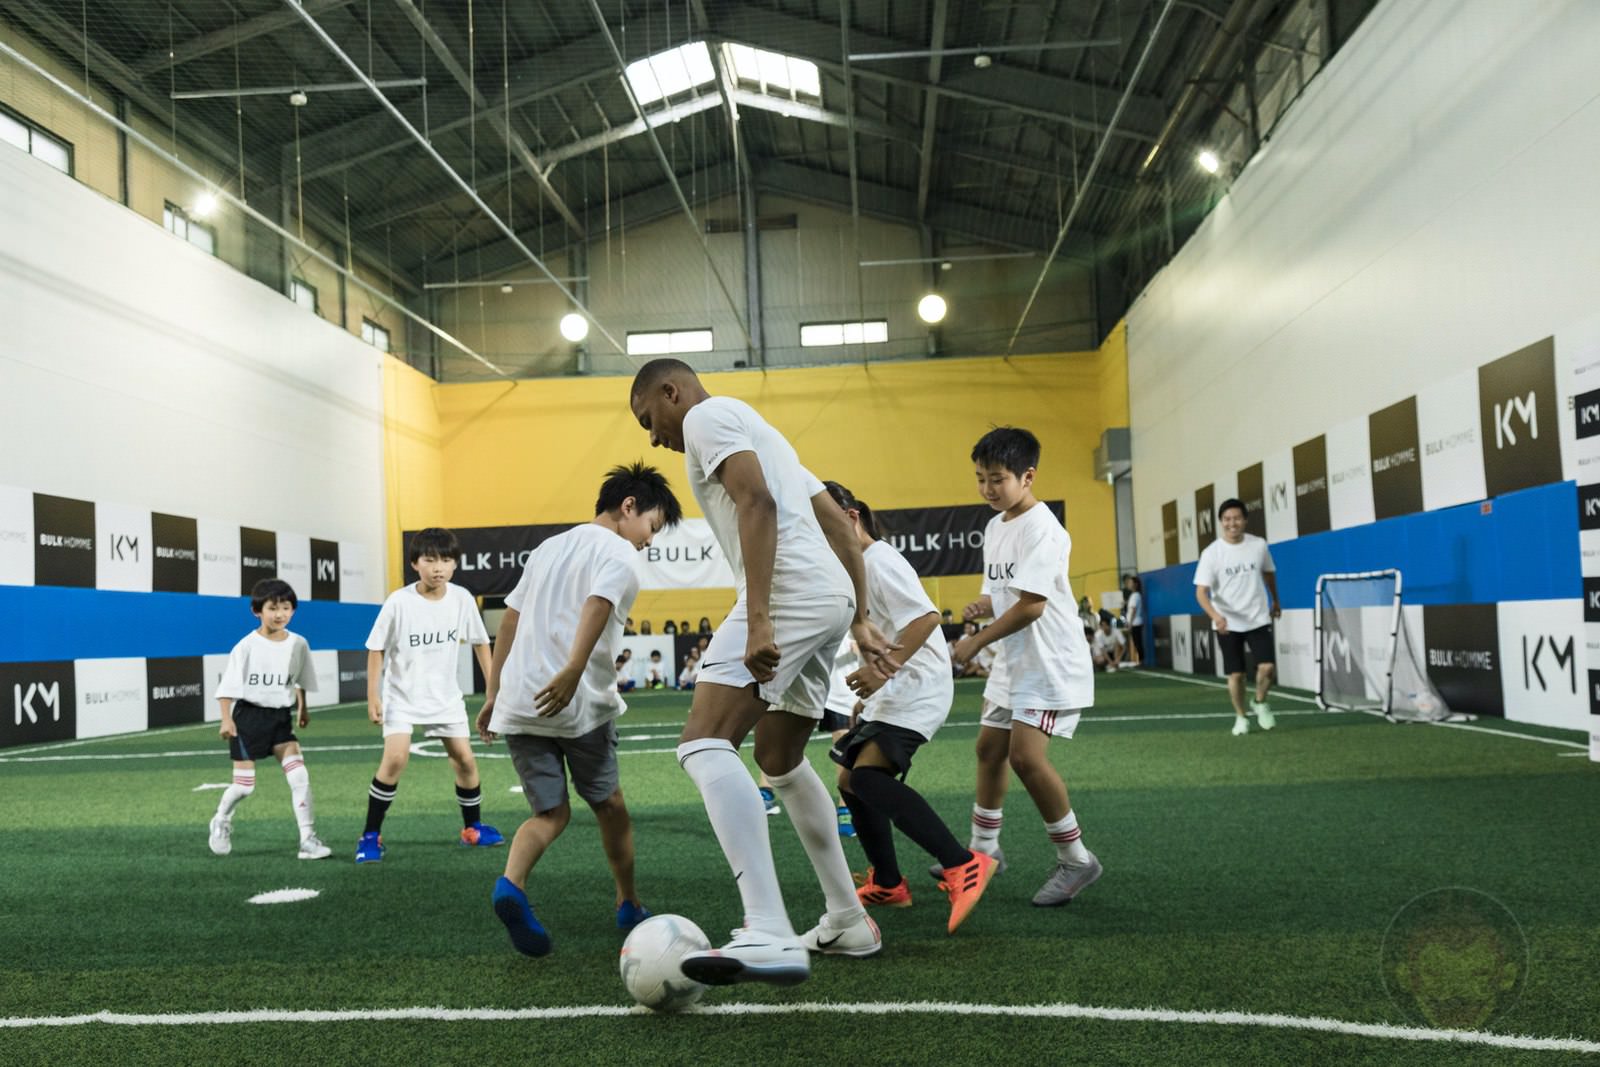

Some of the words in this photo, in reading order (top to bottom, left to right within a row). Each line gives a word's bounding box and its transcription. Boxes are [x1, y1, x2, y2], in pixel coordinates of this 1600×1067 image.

[1494, 390, 1538, 449] KM
[1373, 455, 1390, 473] BULK
[40, 533, 63, 547] BULK
[110, 533, 139, 562] KM
[891, 532, 941, 551] ULK
[155, 546, 174, 558] BULK
[648, 545, 713, 562] BULK
[317, 558, 336, 583] KM
[461, 552, 492, 571] LK
[988, 563, 1014, 581] ULK
[409, 630, 457, 647] BULK
[1429, 649, 1453, 667] BULK
[1523, 634, 1577, 695] KM
[248, 673, 295, 687] BULK
[86, 692, 109, 705] BULK
[153, 686, 175, 700] BULK
[14, 681, 60, 725] KM
